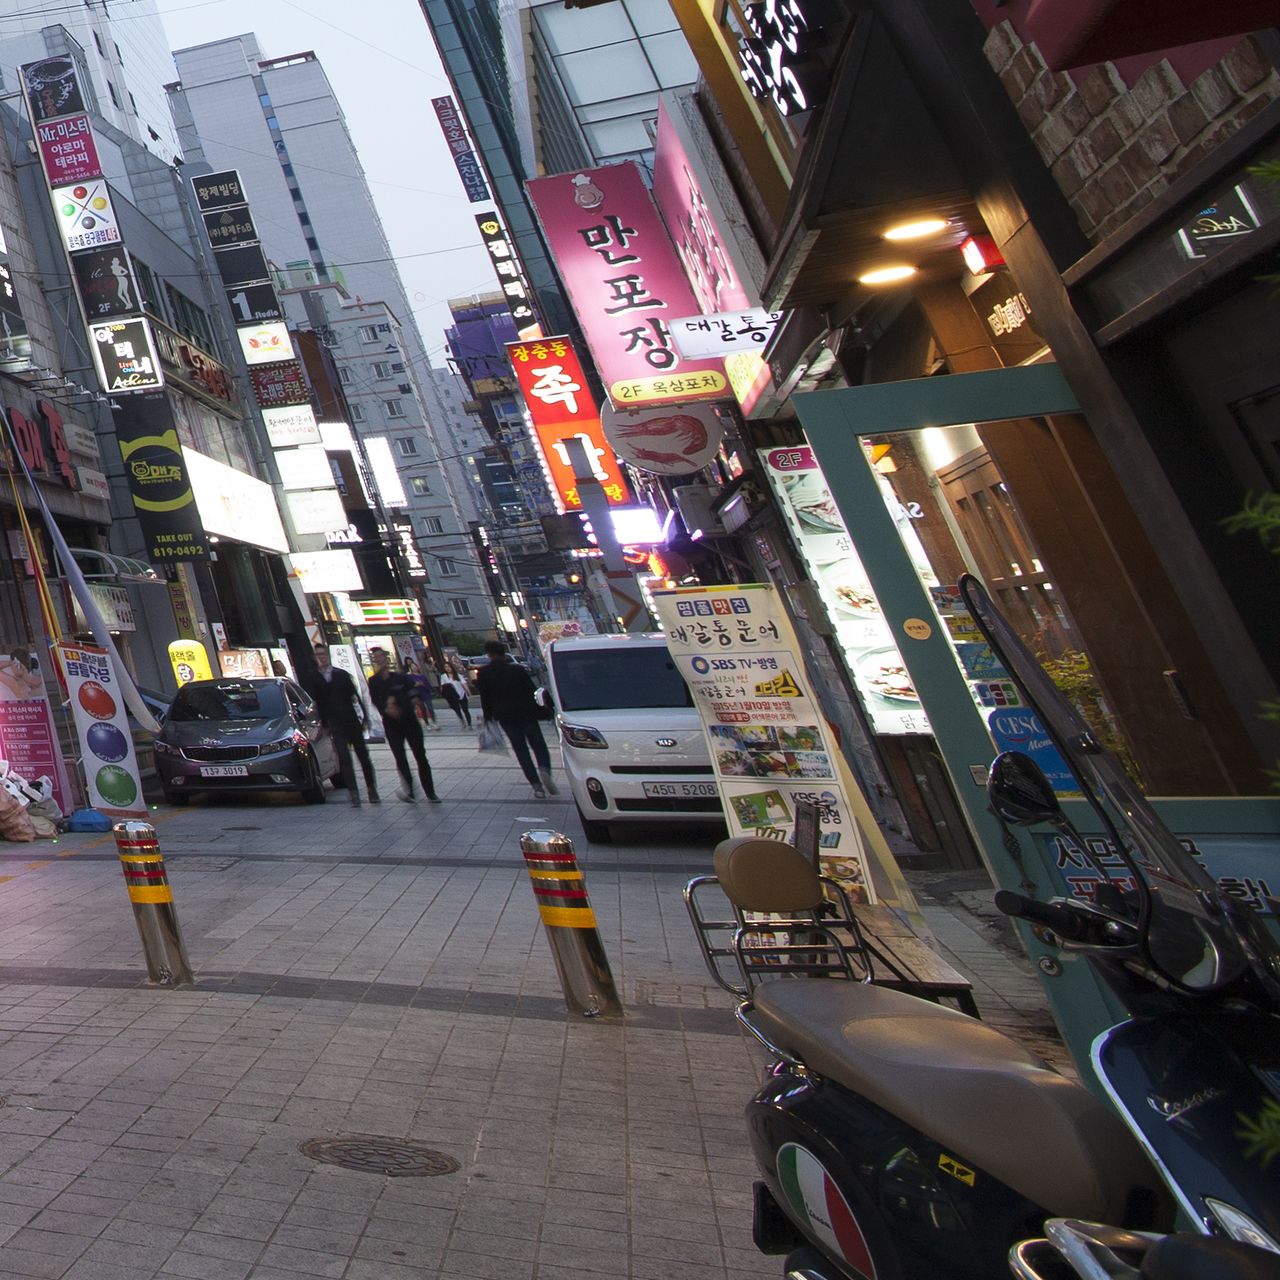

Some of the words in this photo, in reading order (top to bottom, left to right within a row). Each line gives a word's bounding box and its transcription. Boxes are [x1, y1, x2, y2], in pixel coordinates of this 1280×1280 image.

[50, 139, 85, 155] 아로마
[54, 151, 90, 168] 테라피
[198, 182, 241, 201] 황제빌딩
[577, 214, 682, 373] 만포장
[99, 302, 112, 313] 2F
[685, 319, 768, 343] 대갈통
[95, 327, 150, 376] 아테네
[512, 341, 569, 363] 장충동
[619, 383, 640, 399] 2F
[653, 376, 719, 396] 옥상포차
[776, 451, 803, 468] 2F
[155, 534, 172, 545] TAKE
[173, 533, 193, 544] OUT
[153, 544, 204, 557] 819-0492
[676, 597, 752, 618] 명품맛집
[669, 619, 733, 648] 대갈통
[736, 619, 780, 644] 문어
[710, 658, 737, 670] SBS
[737, 656, 778, 670] TV-방영
[981, 689, 1017, 700] JCB
[711, 701, 738, 711] 2015년
[681, 783, 716, 797] 5208
